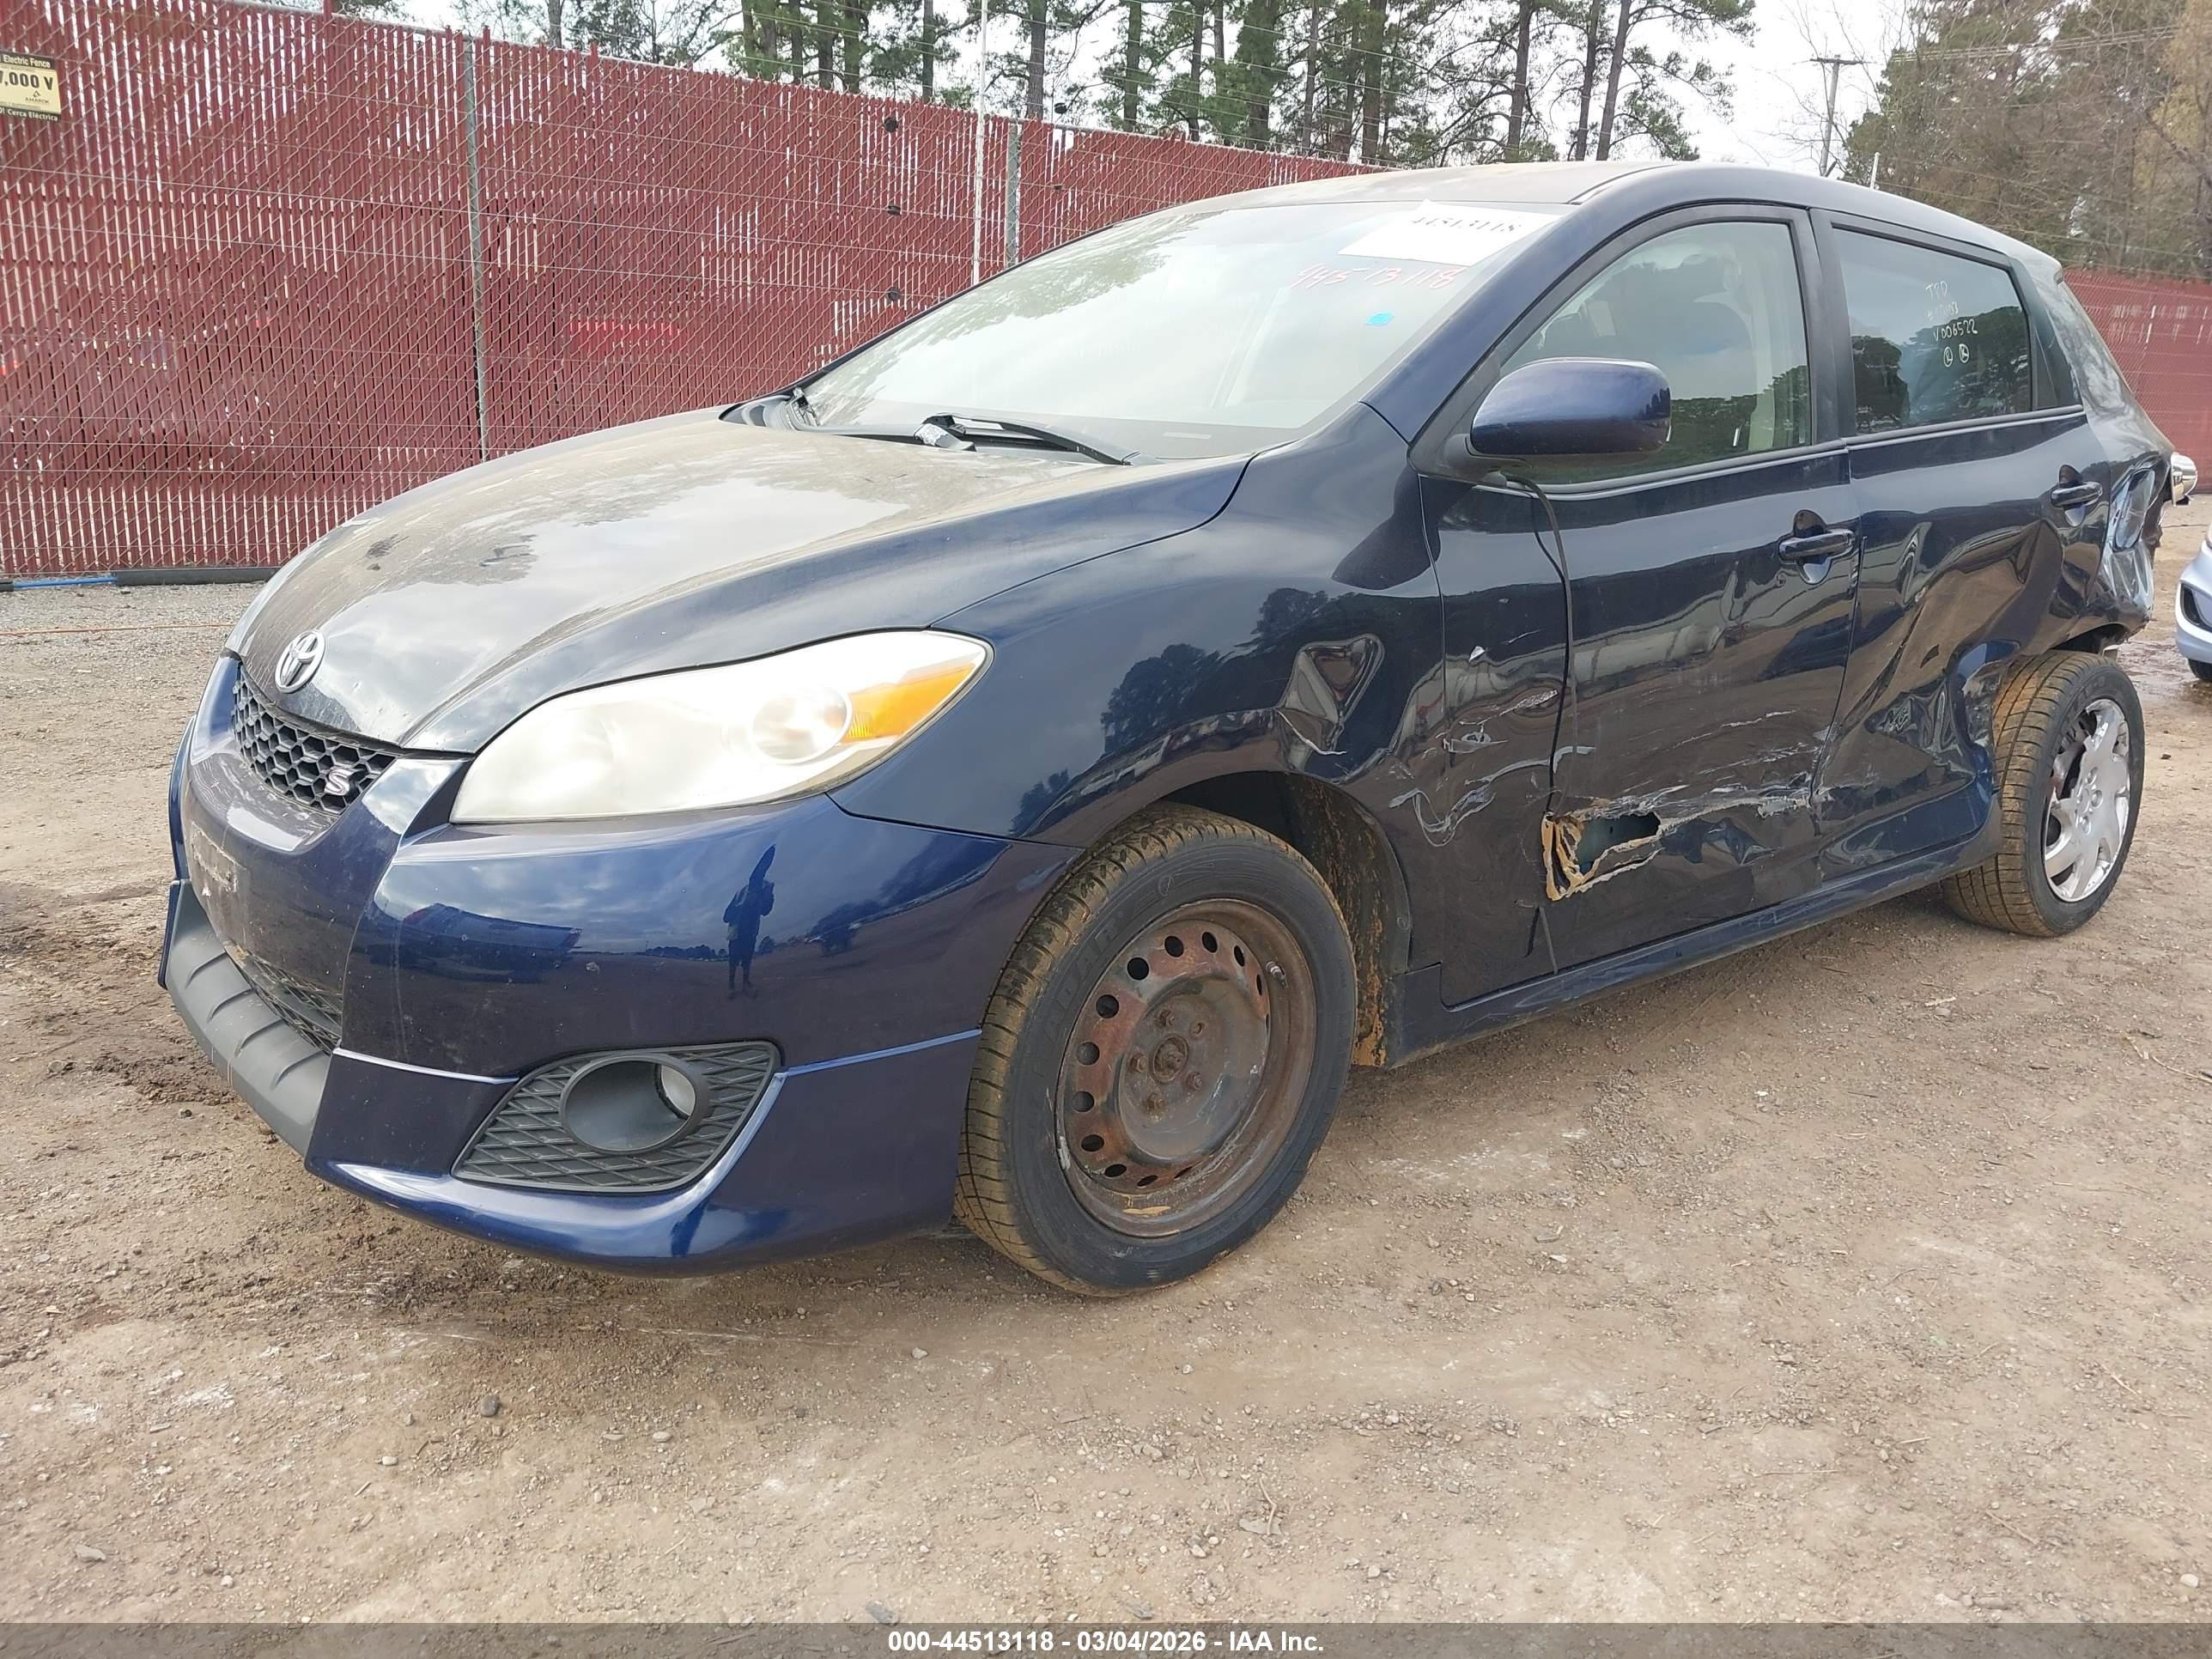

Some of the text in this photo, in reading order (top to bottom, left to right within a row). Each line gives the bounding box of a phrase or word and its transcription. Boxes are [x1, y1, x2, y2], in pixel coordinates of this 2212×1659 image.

[3, 54, 29, 66] Electric
[29, 57, 51, 69] Fence
[43, 76, 53, 90] V
[7, 108, 27, 118] Cerca
[325, 766, 350, 795] S
